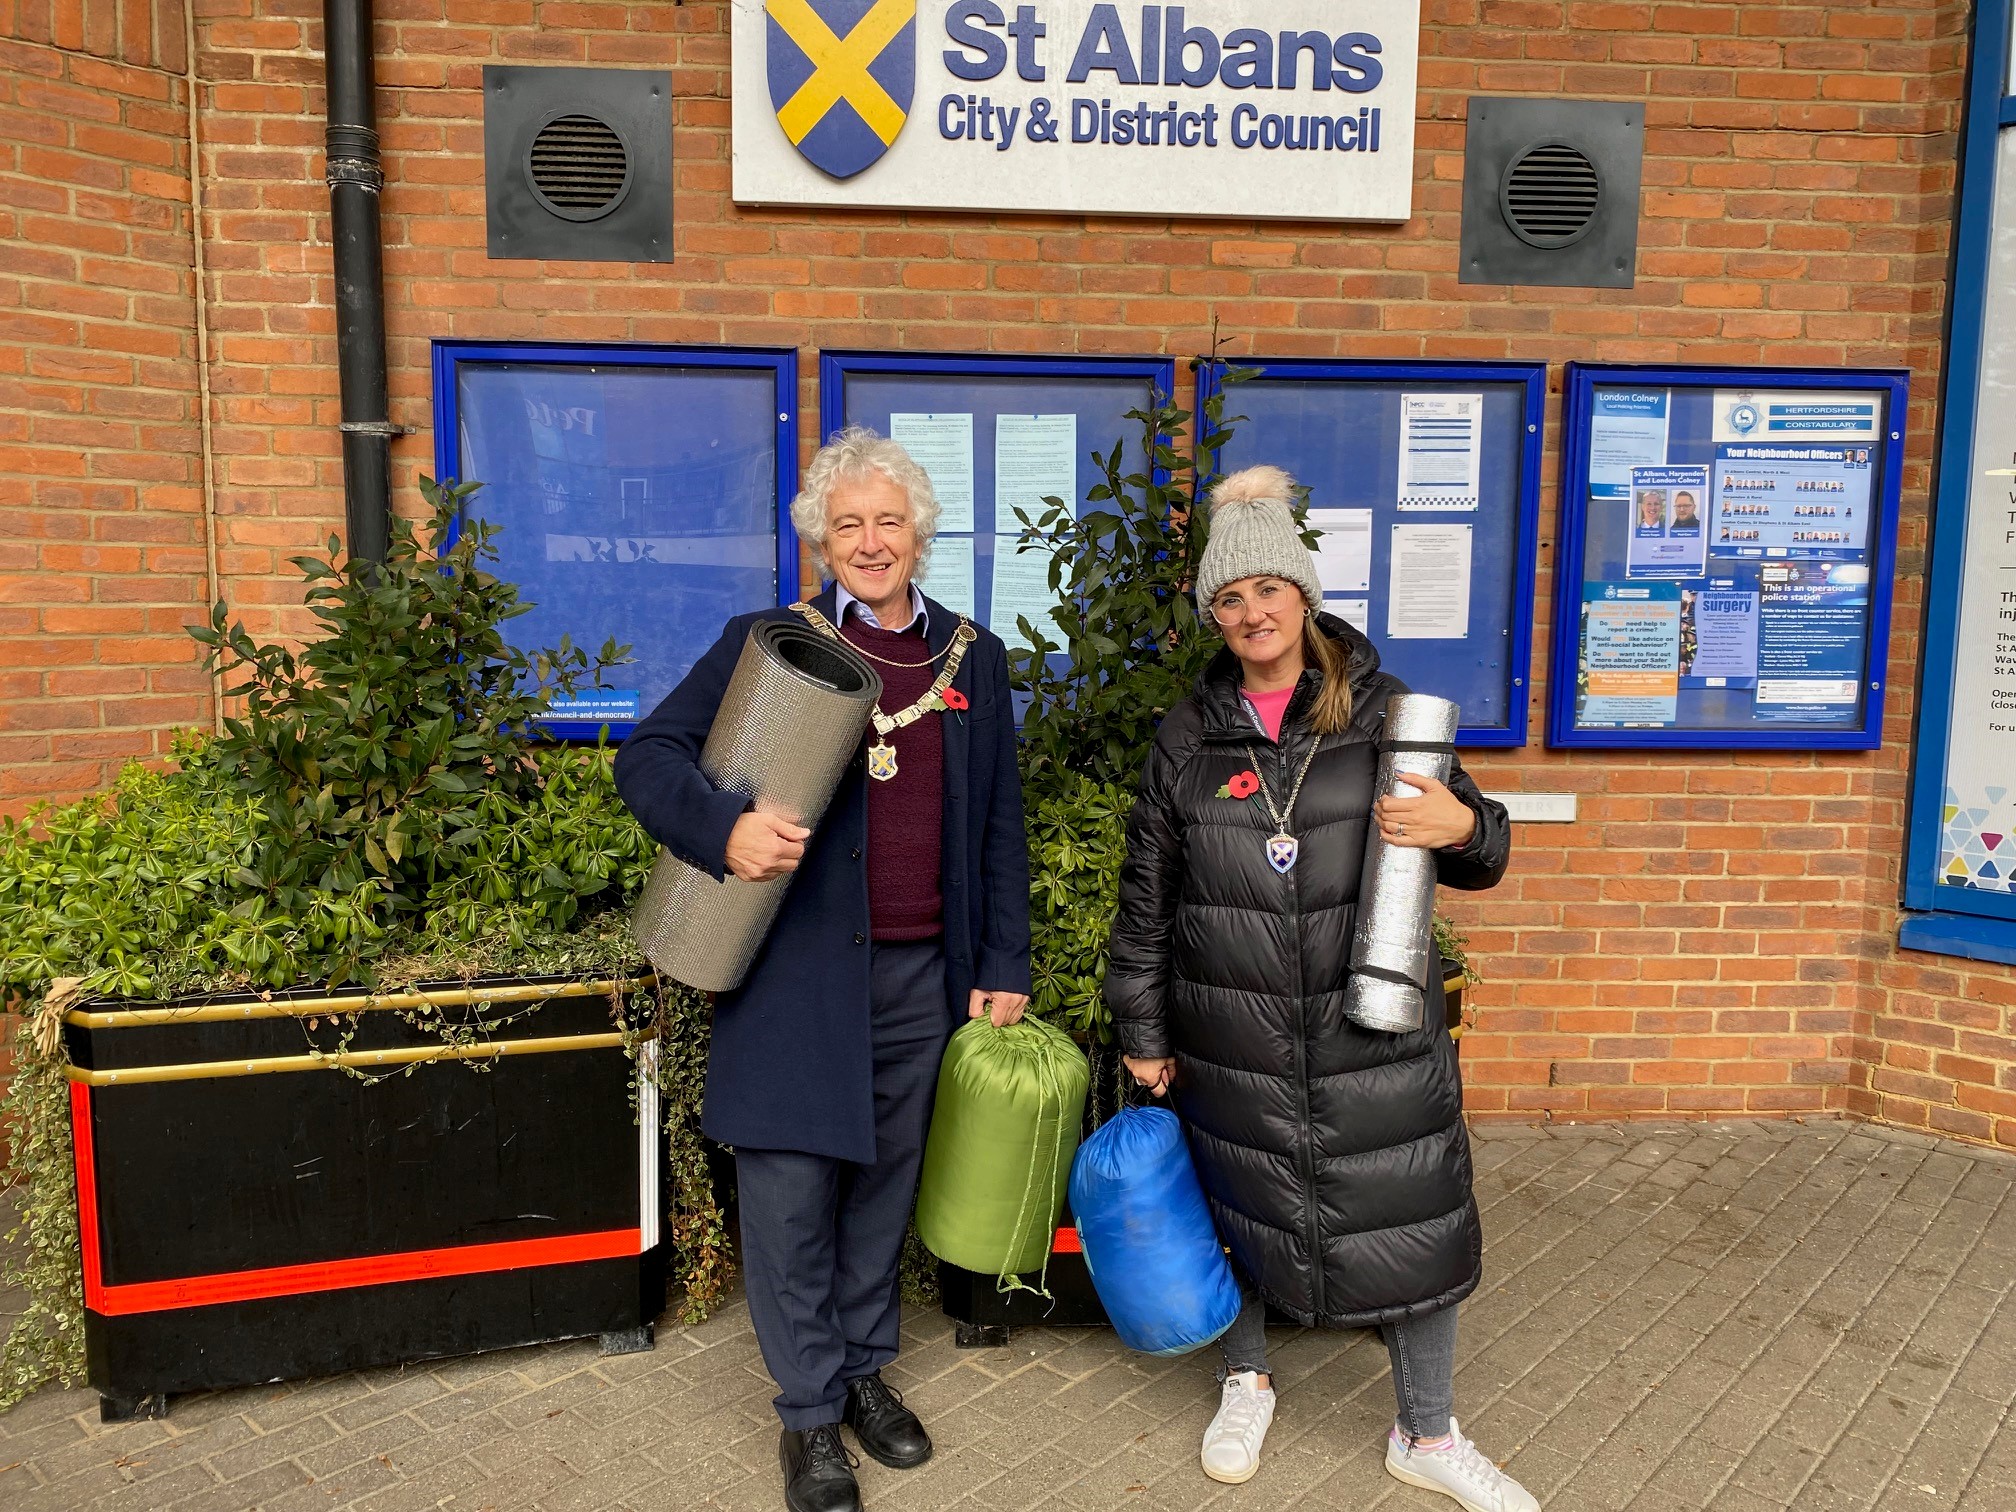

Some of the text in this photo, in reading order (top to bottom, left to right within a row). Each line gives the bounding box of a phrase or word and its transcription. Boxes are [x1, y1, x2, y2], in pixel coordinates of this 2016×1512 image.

[943, 0, 1384, 92] St Albans
[938, 94, 1380, 152] City & District Council
[1600, 394, 1659, 404] London Colney
[1727, 448, 1842, 460] Your Neighbourhood Officers
[1807, 584, 1856, 593] operational
[1703, 592, 1751, 600] Neighbourhood
[1762, 594, 1788, 602] police
[1703, 601, 1752, 612] surgery
[1997, 633, 2015, 641] The
[1996, 644, 2006, 652] St
[1994, 667, 2004, 675] St
[1990, 723, 2006, 731] For
